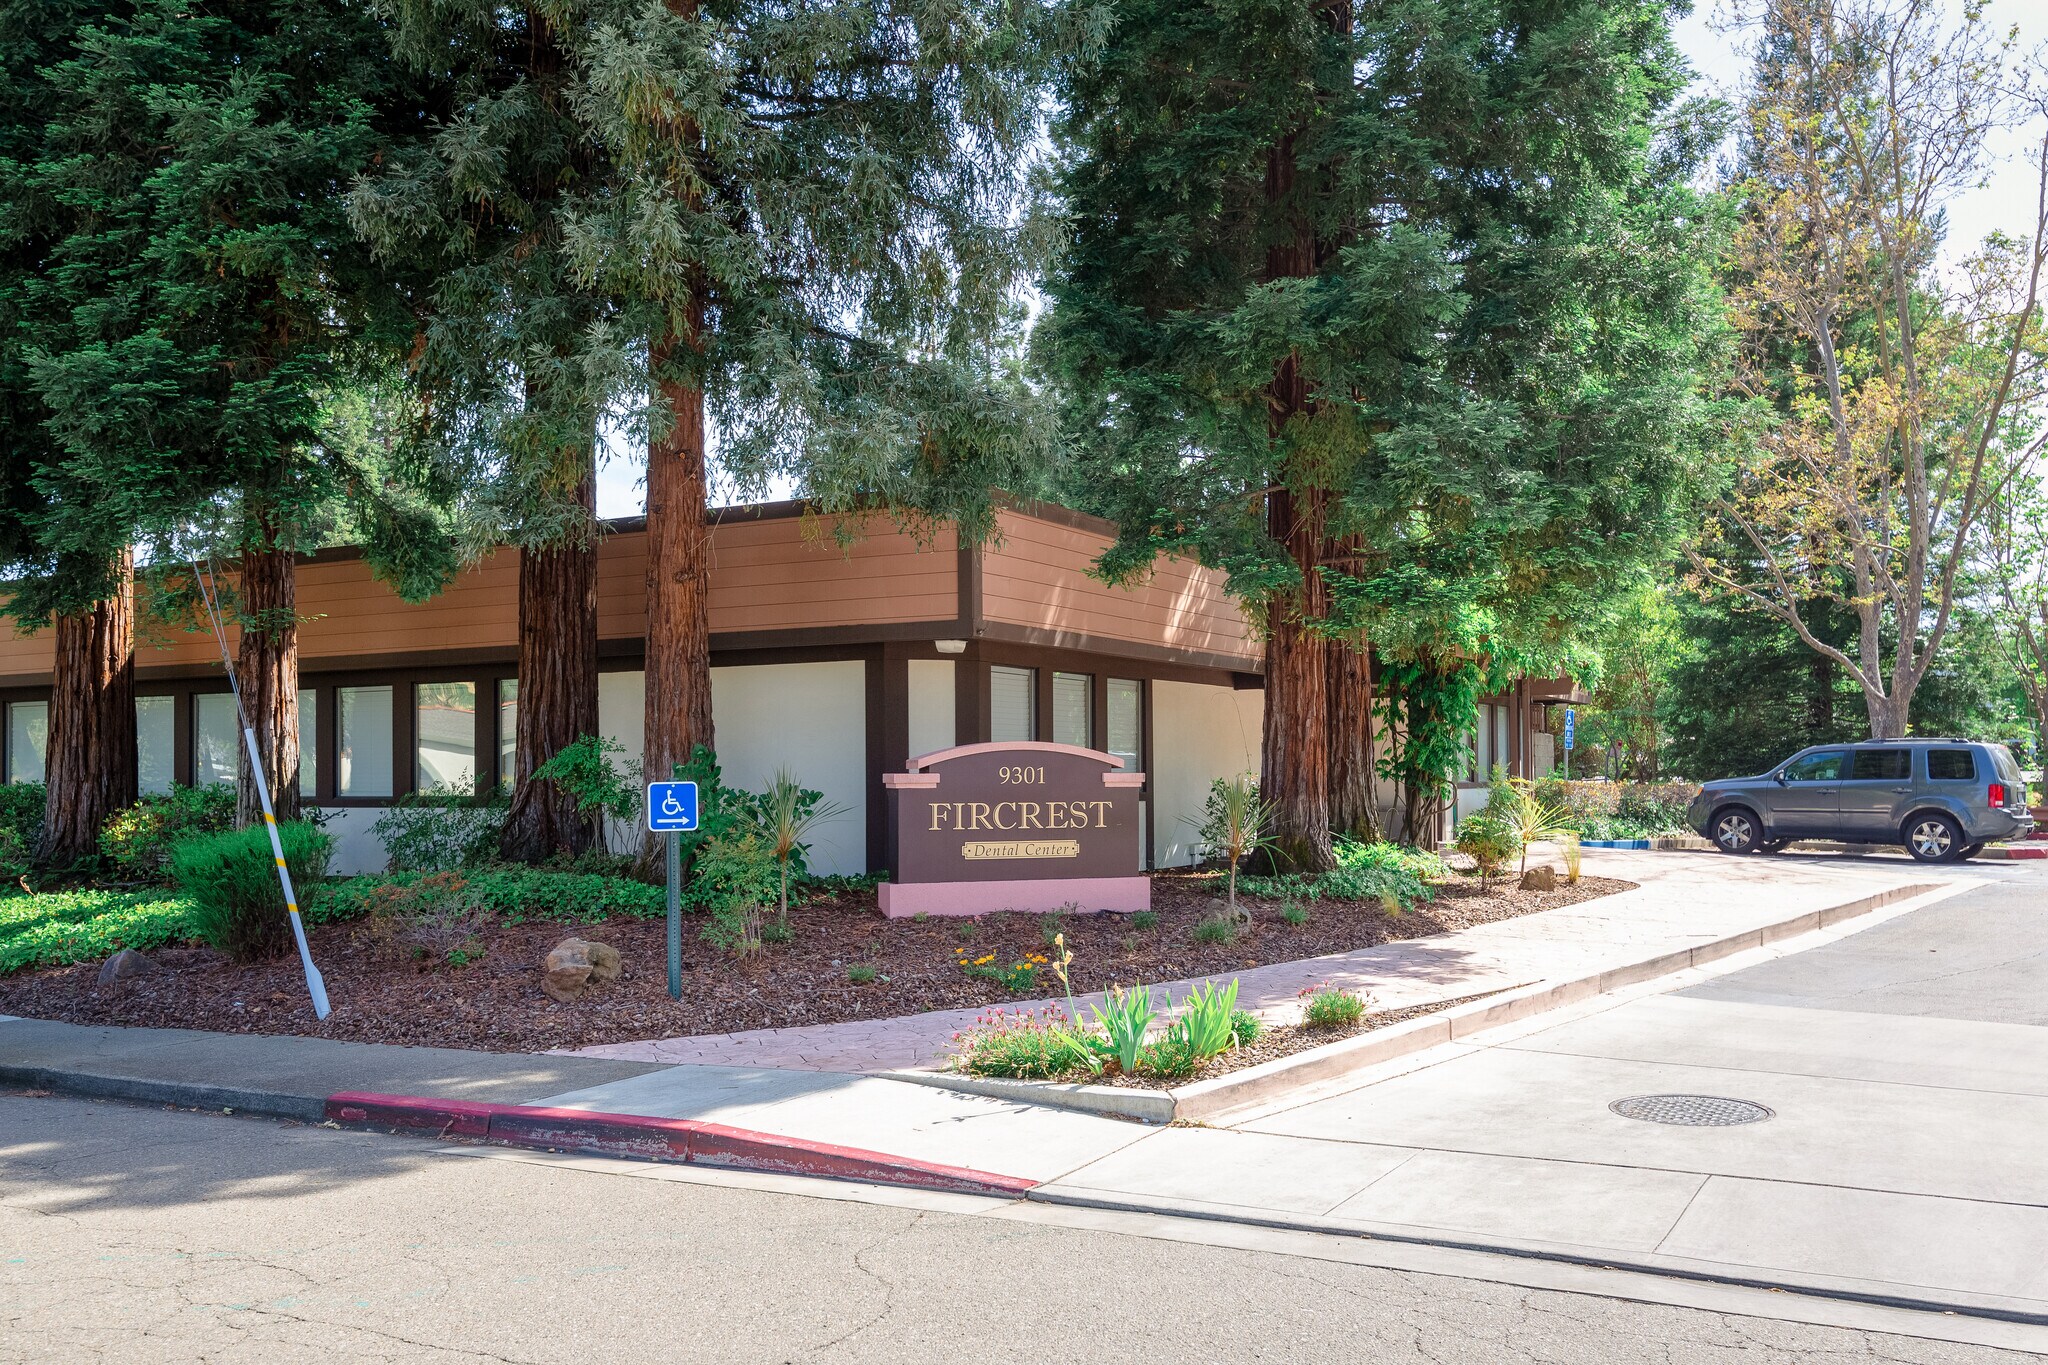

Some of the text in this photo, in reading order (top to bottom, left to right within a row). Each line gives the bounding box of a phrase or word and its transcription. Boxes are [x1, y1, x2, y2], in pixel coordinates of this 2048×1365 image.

[998, 766, 1046, 785] 9301
[928, 801, 1113, 831] FIRCREST
[974, 843, 1069, 858] Dental Center
